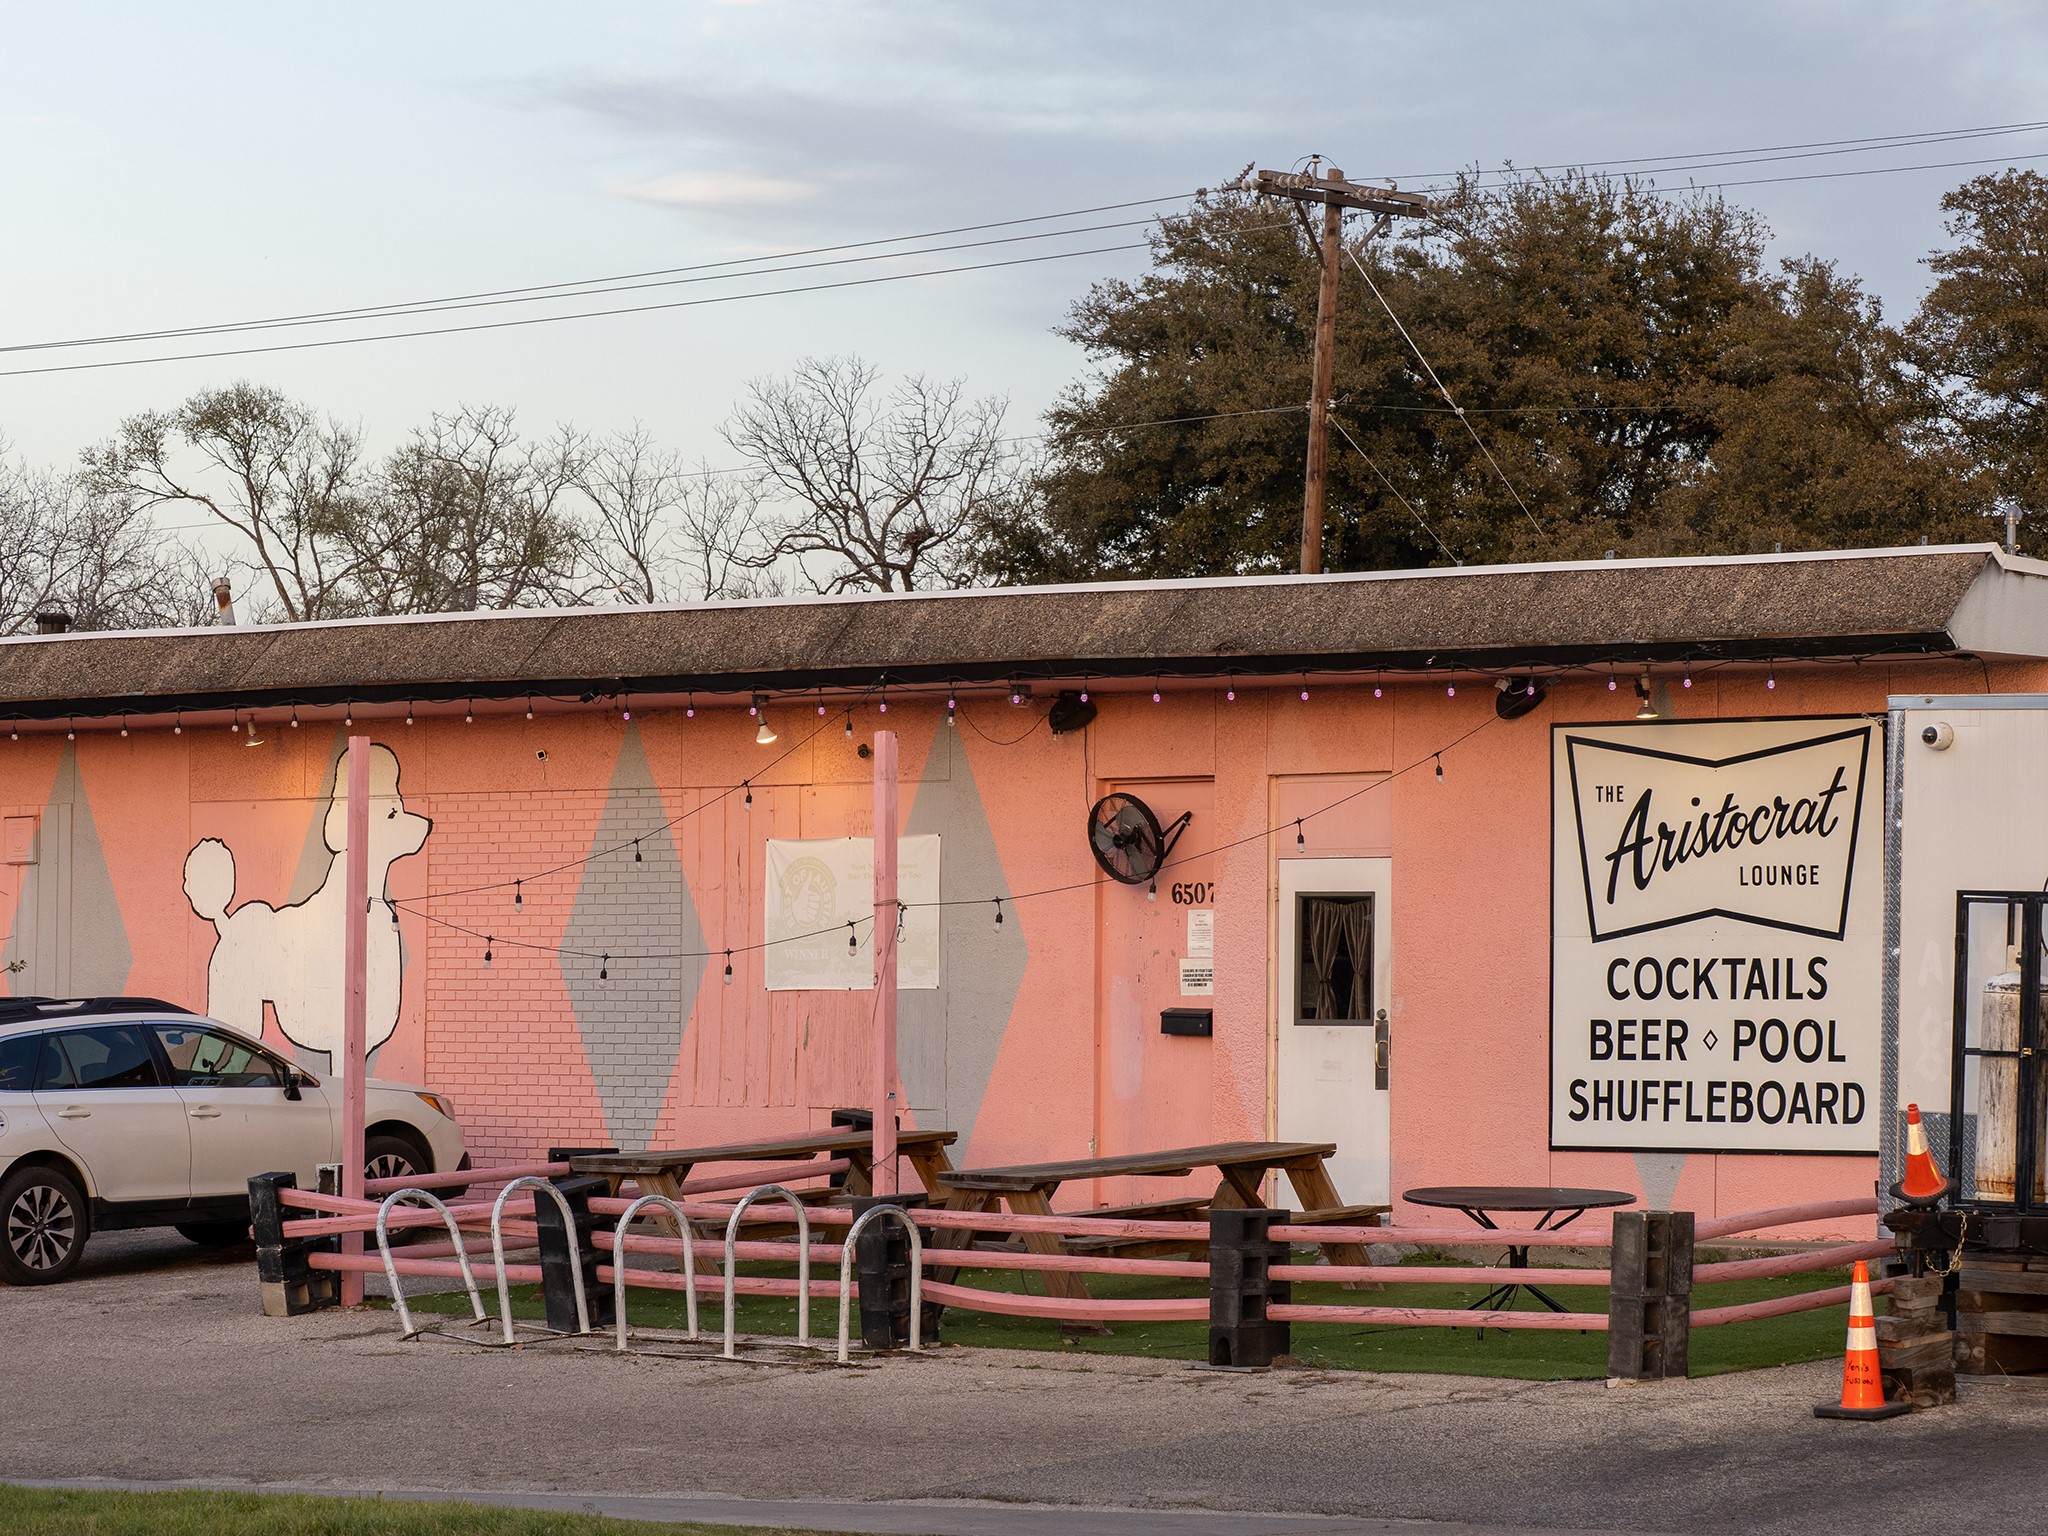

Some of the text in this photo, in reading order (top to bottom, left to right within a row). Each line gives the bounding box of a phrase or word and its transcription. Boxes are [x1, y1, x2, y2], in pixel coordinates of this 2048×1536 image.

[1595, 785, 1624, 803] THE
[1605, 766, 1847, 905] Aristocrat
[1739, 864, 1820, 887] LOUNGE
[783, 868, 833, 929] BEST OF AUSTIN
[783, 948, 830, 960] WINNER
[1606, 956, 1828, 1001] COCKTAILS
[1589, 1018, 1846, 1064] BEER POOL
[1568, 1078, 1866, 1126] SHUFFLEBOARD
